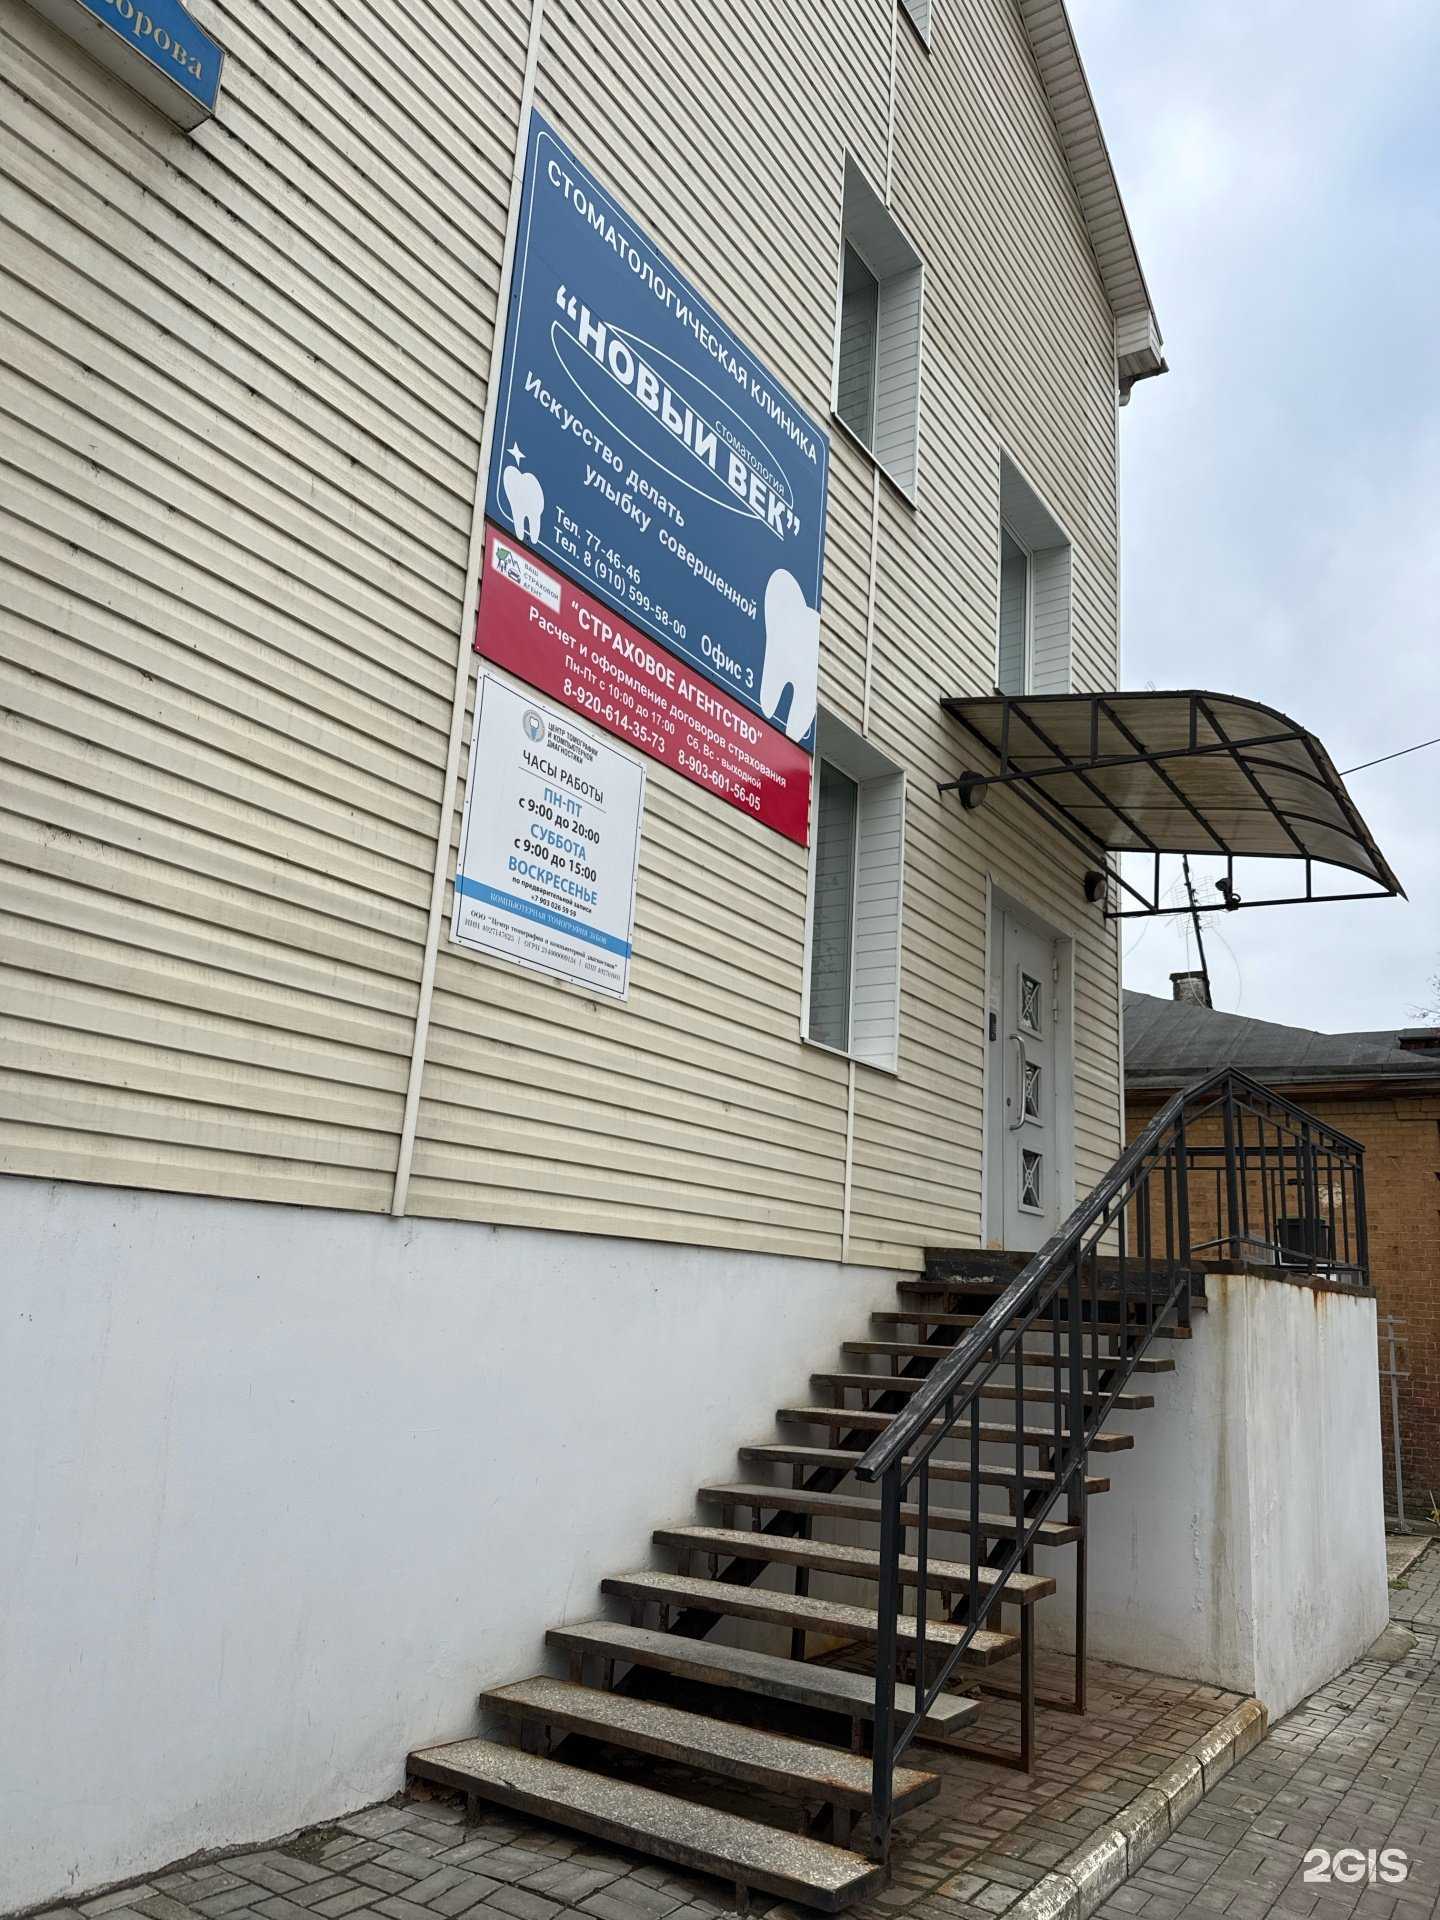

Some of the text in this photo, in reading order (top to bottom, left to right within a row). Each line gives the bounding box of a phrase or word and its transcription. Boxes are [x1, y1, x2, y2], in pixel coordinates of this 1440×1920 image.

[105, 0, 202, 80] орова
[548, 160, 817, 465] СТОМАТОЛОГИЧЕСКАЯ КЛИНИКА
[524, 370, 685, 527] Искусство делать
[555, 505, 641, 584] Тел. 77-46-46
[584, 464, 757, 620] улыбку совершенной
[553, 526, 687, 639] Тел. 8 (910) 599-58-00
[529, 606, 787, 788] Расчет и оформление договоров страхования
[571, 600, 763, 745] "СТРАХОВОЕ АГЕНТСТВО"
[701, 634, 754, 689] Офис 3
[563, 678, 666, 753] 8-920-614-35-73
[678, 749, 761, 811] 8-903-601-56-05
[565, 655, 598, 685] Пн-Пт
[599, 680, 606, 690] с
[608, 684, 634, 709] 10:00
[635, 705, 649, 718] до
[651, 711, 675, 735] 17:00
[703, 745, 715, 760] Вс
[721, 758, 762, 790] выходной
[523, 749, 604, 804] ЧАСЫ РАБОТЫ
[543, 787, 583, 818] ПН-ПТ
[514, 838, 597, 882] с 9:00 до 15:00
[518, 797, 600, 845] с 9:00 до 20:00
[530, 823, 587, 862] СУББОТА
[508, 855, 598, 906] ВОСКРЕСЕНЬЕ
